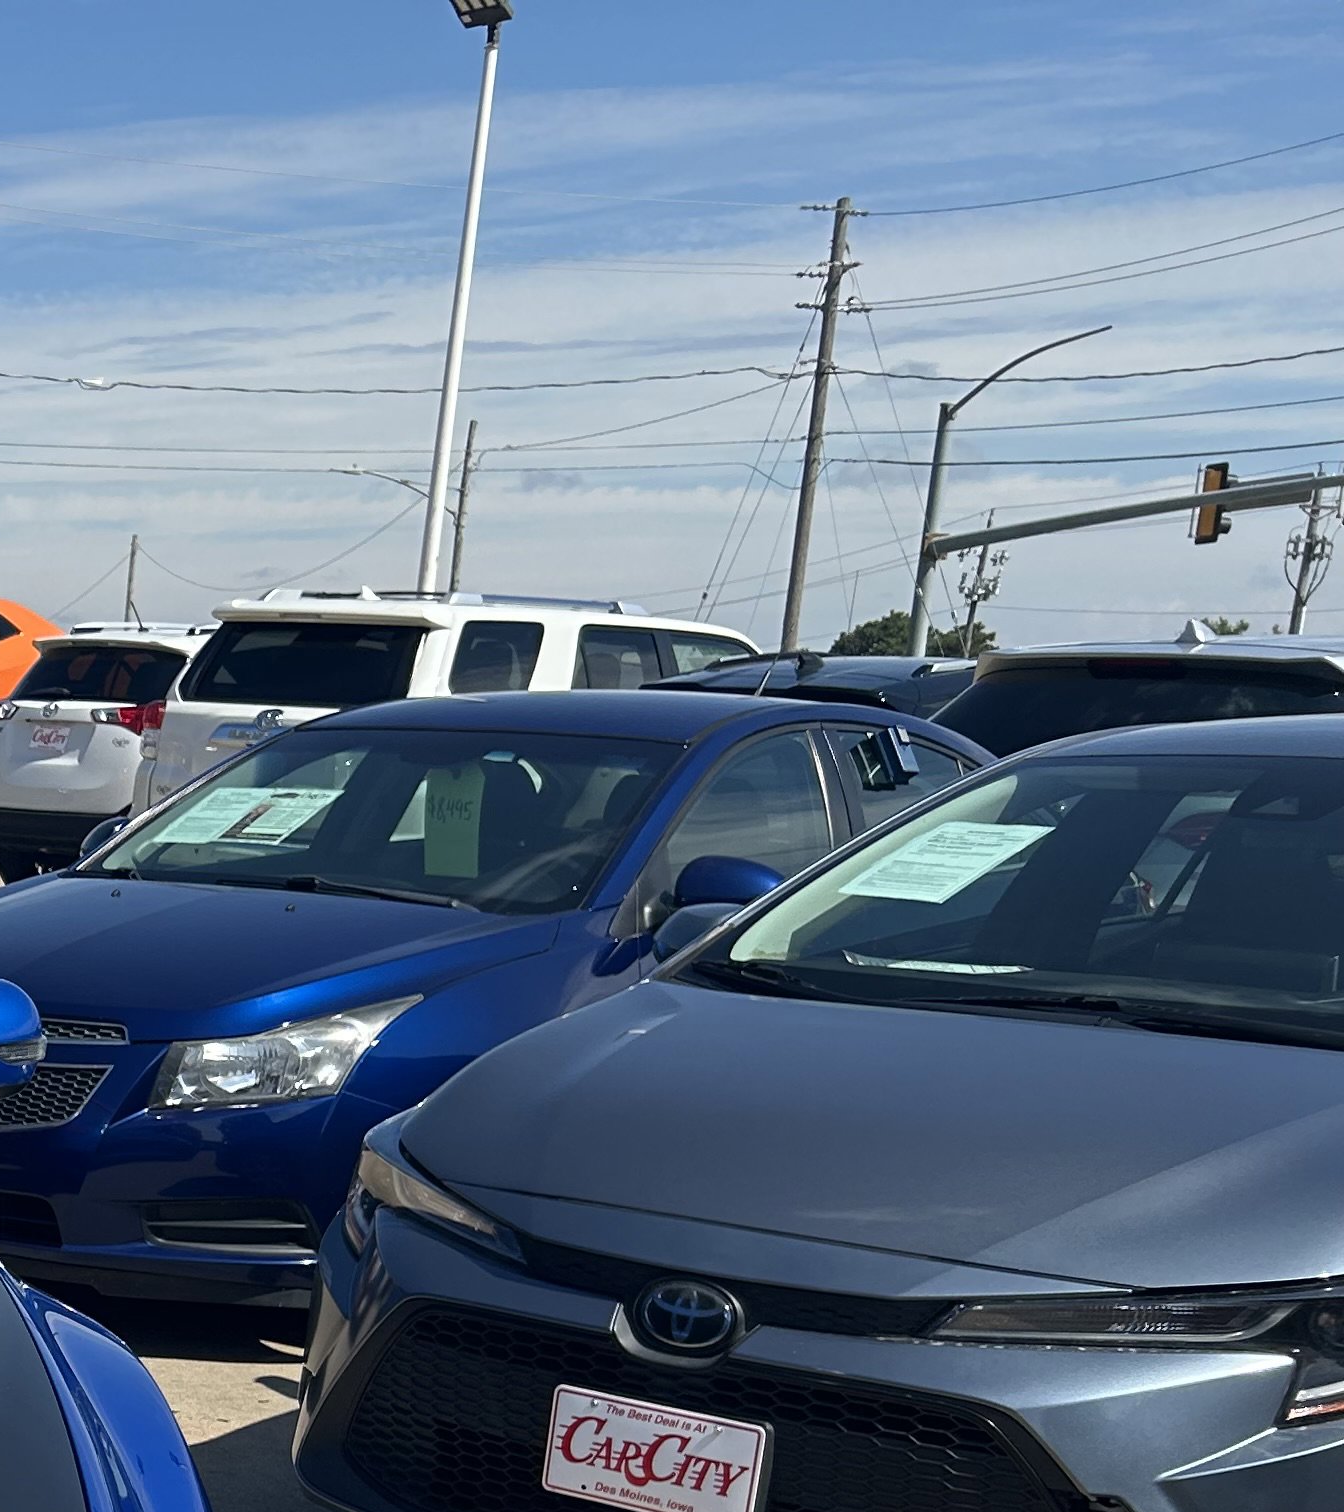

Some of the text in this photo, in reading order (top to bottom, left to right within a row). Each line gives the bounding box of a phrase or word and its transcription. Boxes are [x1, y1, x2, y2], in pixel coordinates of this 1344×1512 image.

[606, 1403, 626, 1417] The
[627, 1409, 653, 1423] Best
[654, 1415, 679, 1429] Deal
[594, 1482, 617, 1495] Des
